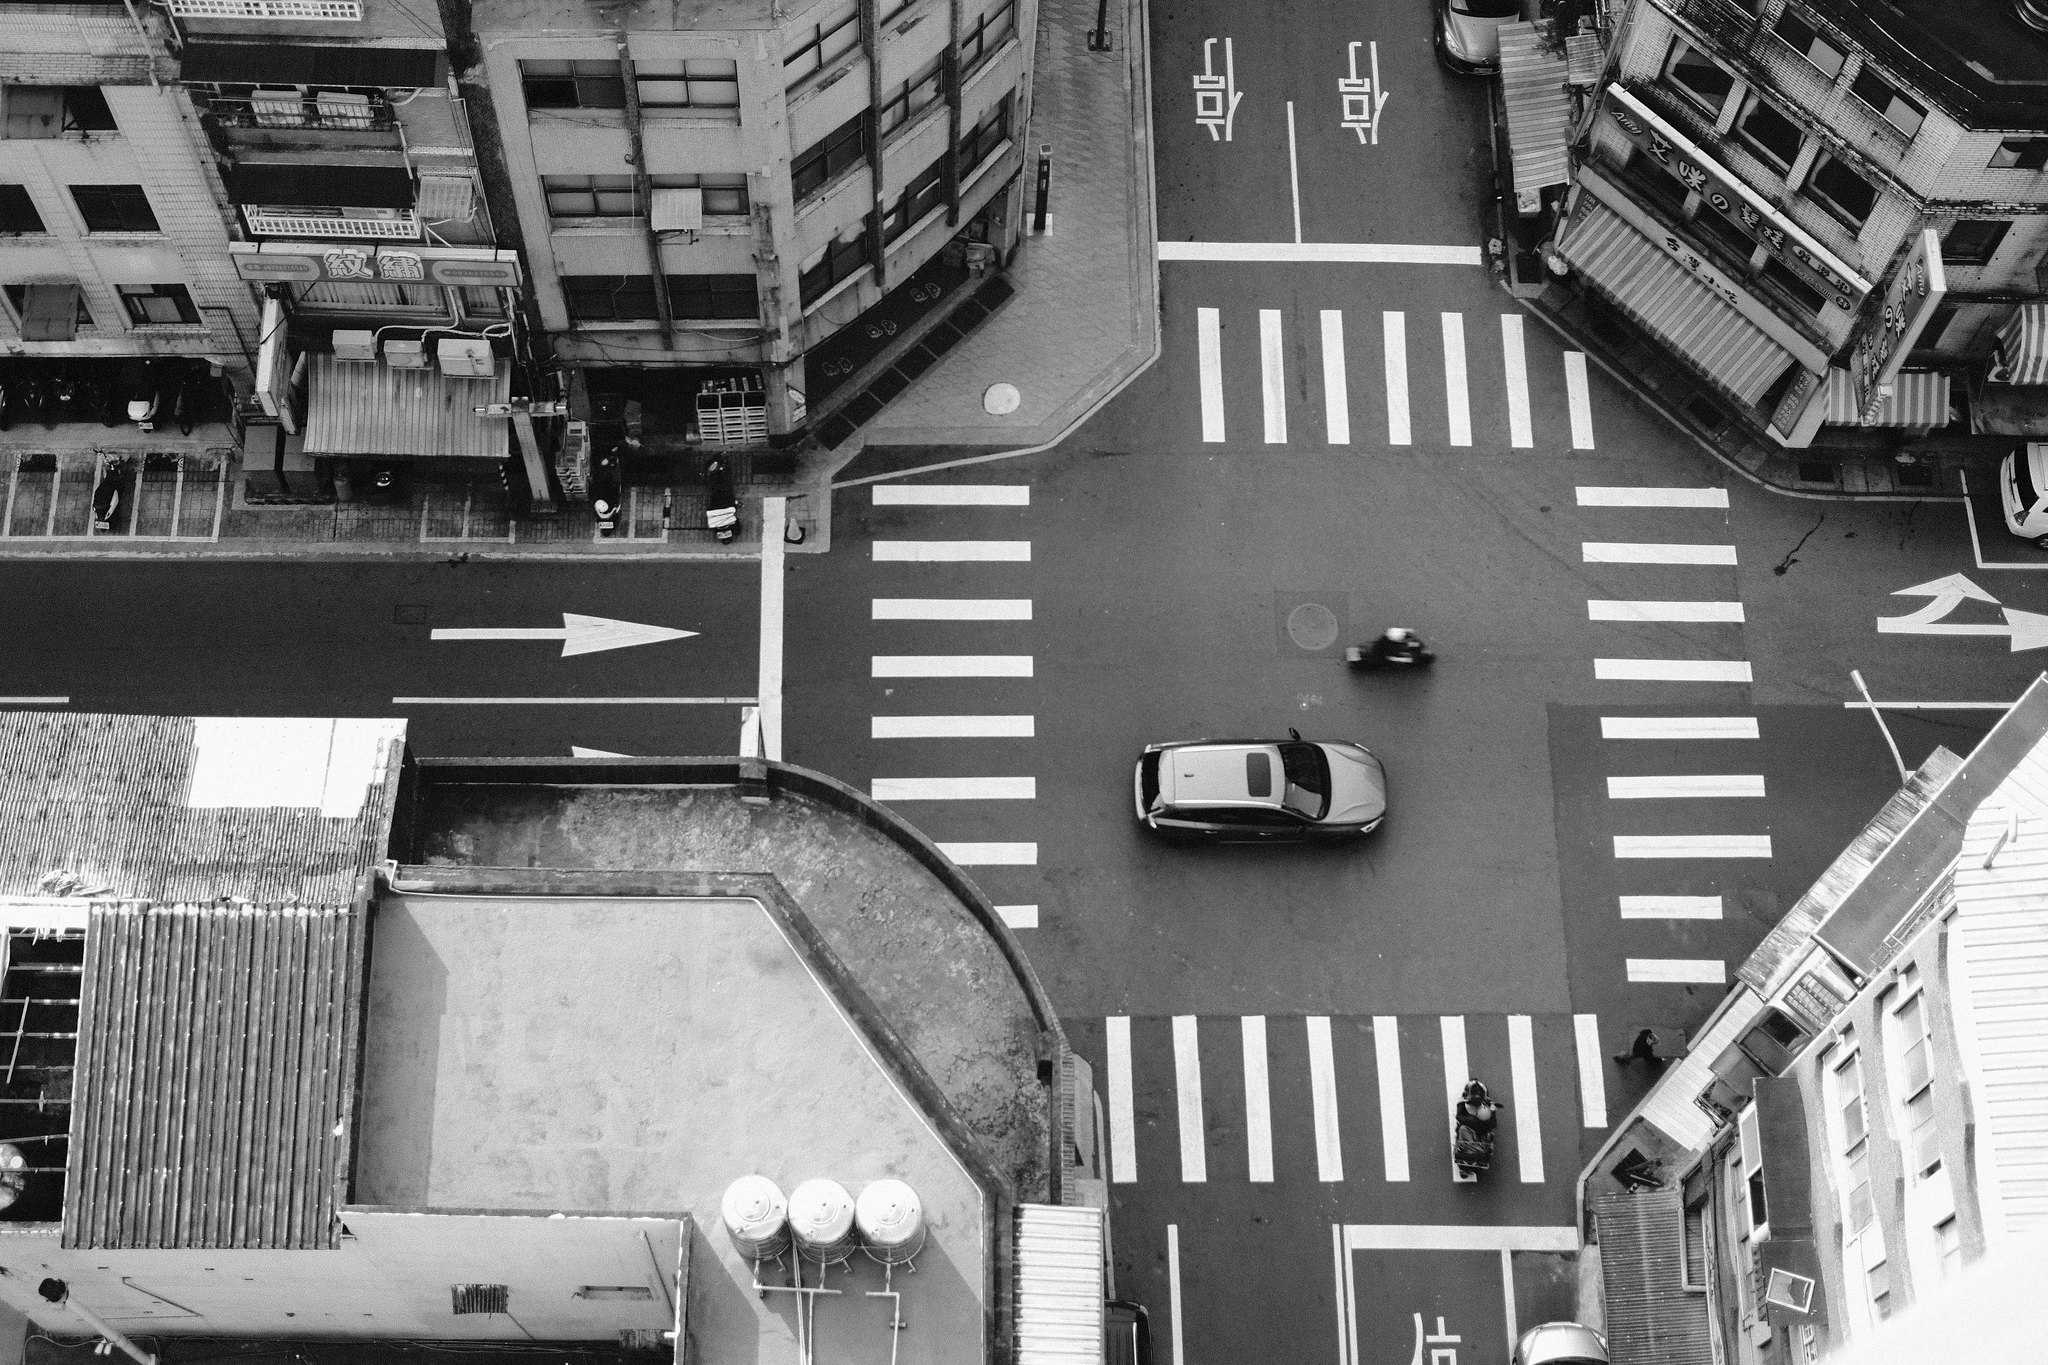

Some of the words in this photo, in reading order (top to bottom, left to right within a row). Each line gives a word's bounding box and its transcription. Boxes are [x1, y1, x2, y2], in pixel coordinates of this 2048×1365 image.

[1193, 37, 1244, 142] 停
[1338, 40, 1390, 145] 停
[1610, 111, 1642, 134] Amy
[1915, 262, 1925, 296] Amy
